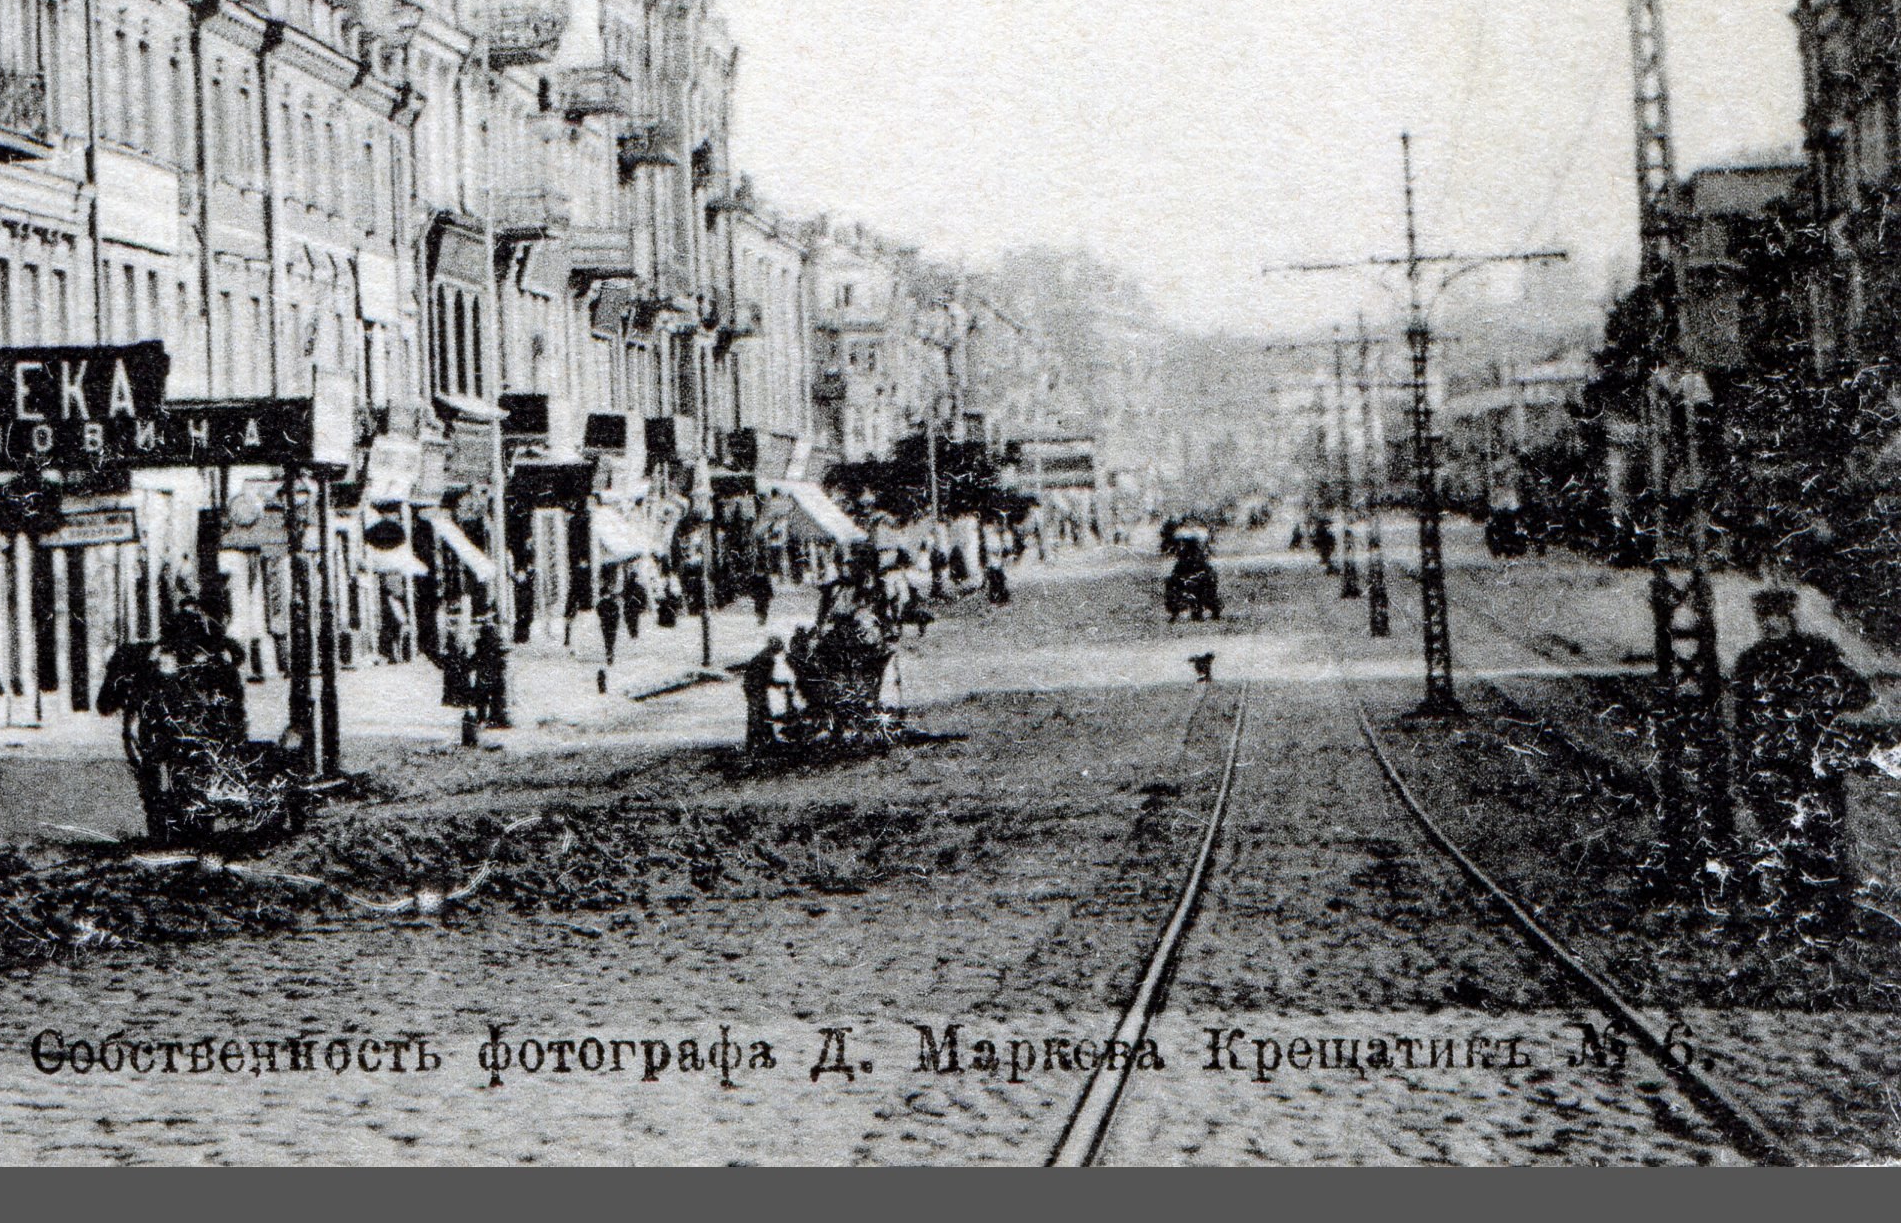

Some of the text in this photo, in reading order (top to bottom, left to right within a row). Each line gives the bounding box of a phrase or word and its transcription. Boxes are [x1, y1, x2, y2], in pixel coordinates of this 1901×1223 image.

[30, 1029, 442, 1076] Собственность
[477, 1025, 778, 1089] фотографа
[809, 1025, 875, 1084] Д.
[1201, 1025, 1533, 1078] Крещатикъ
